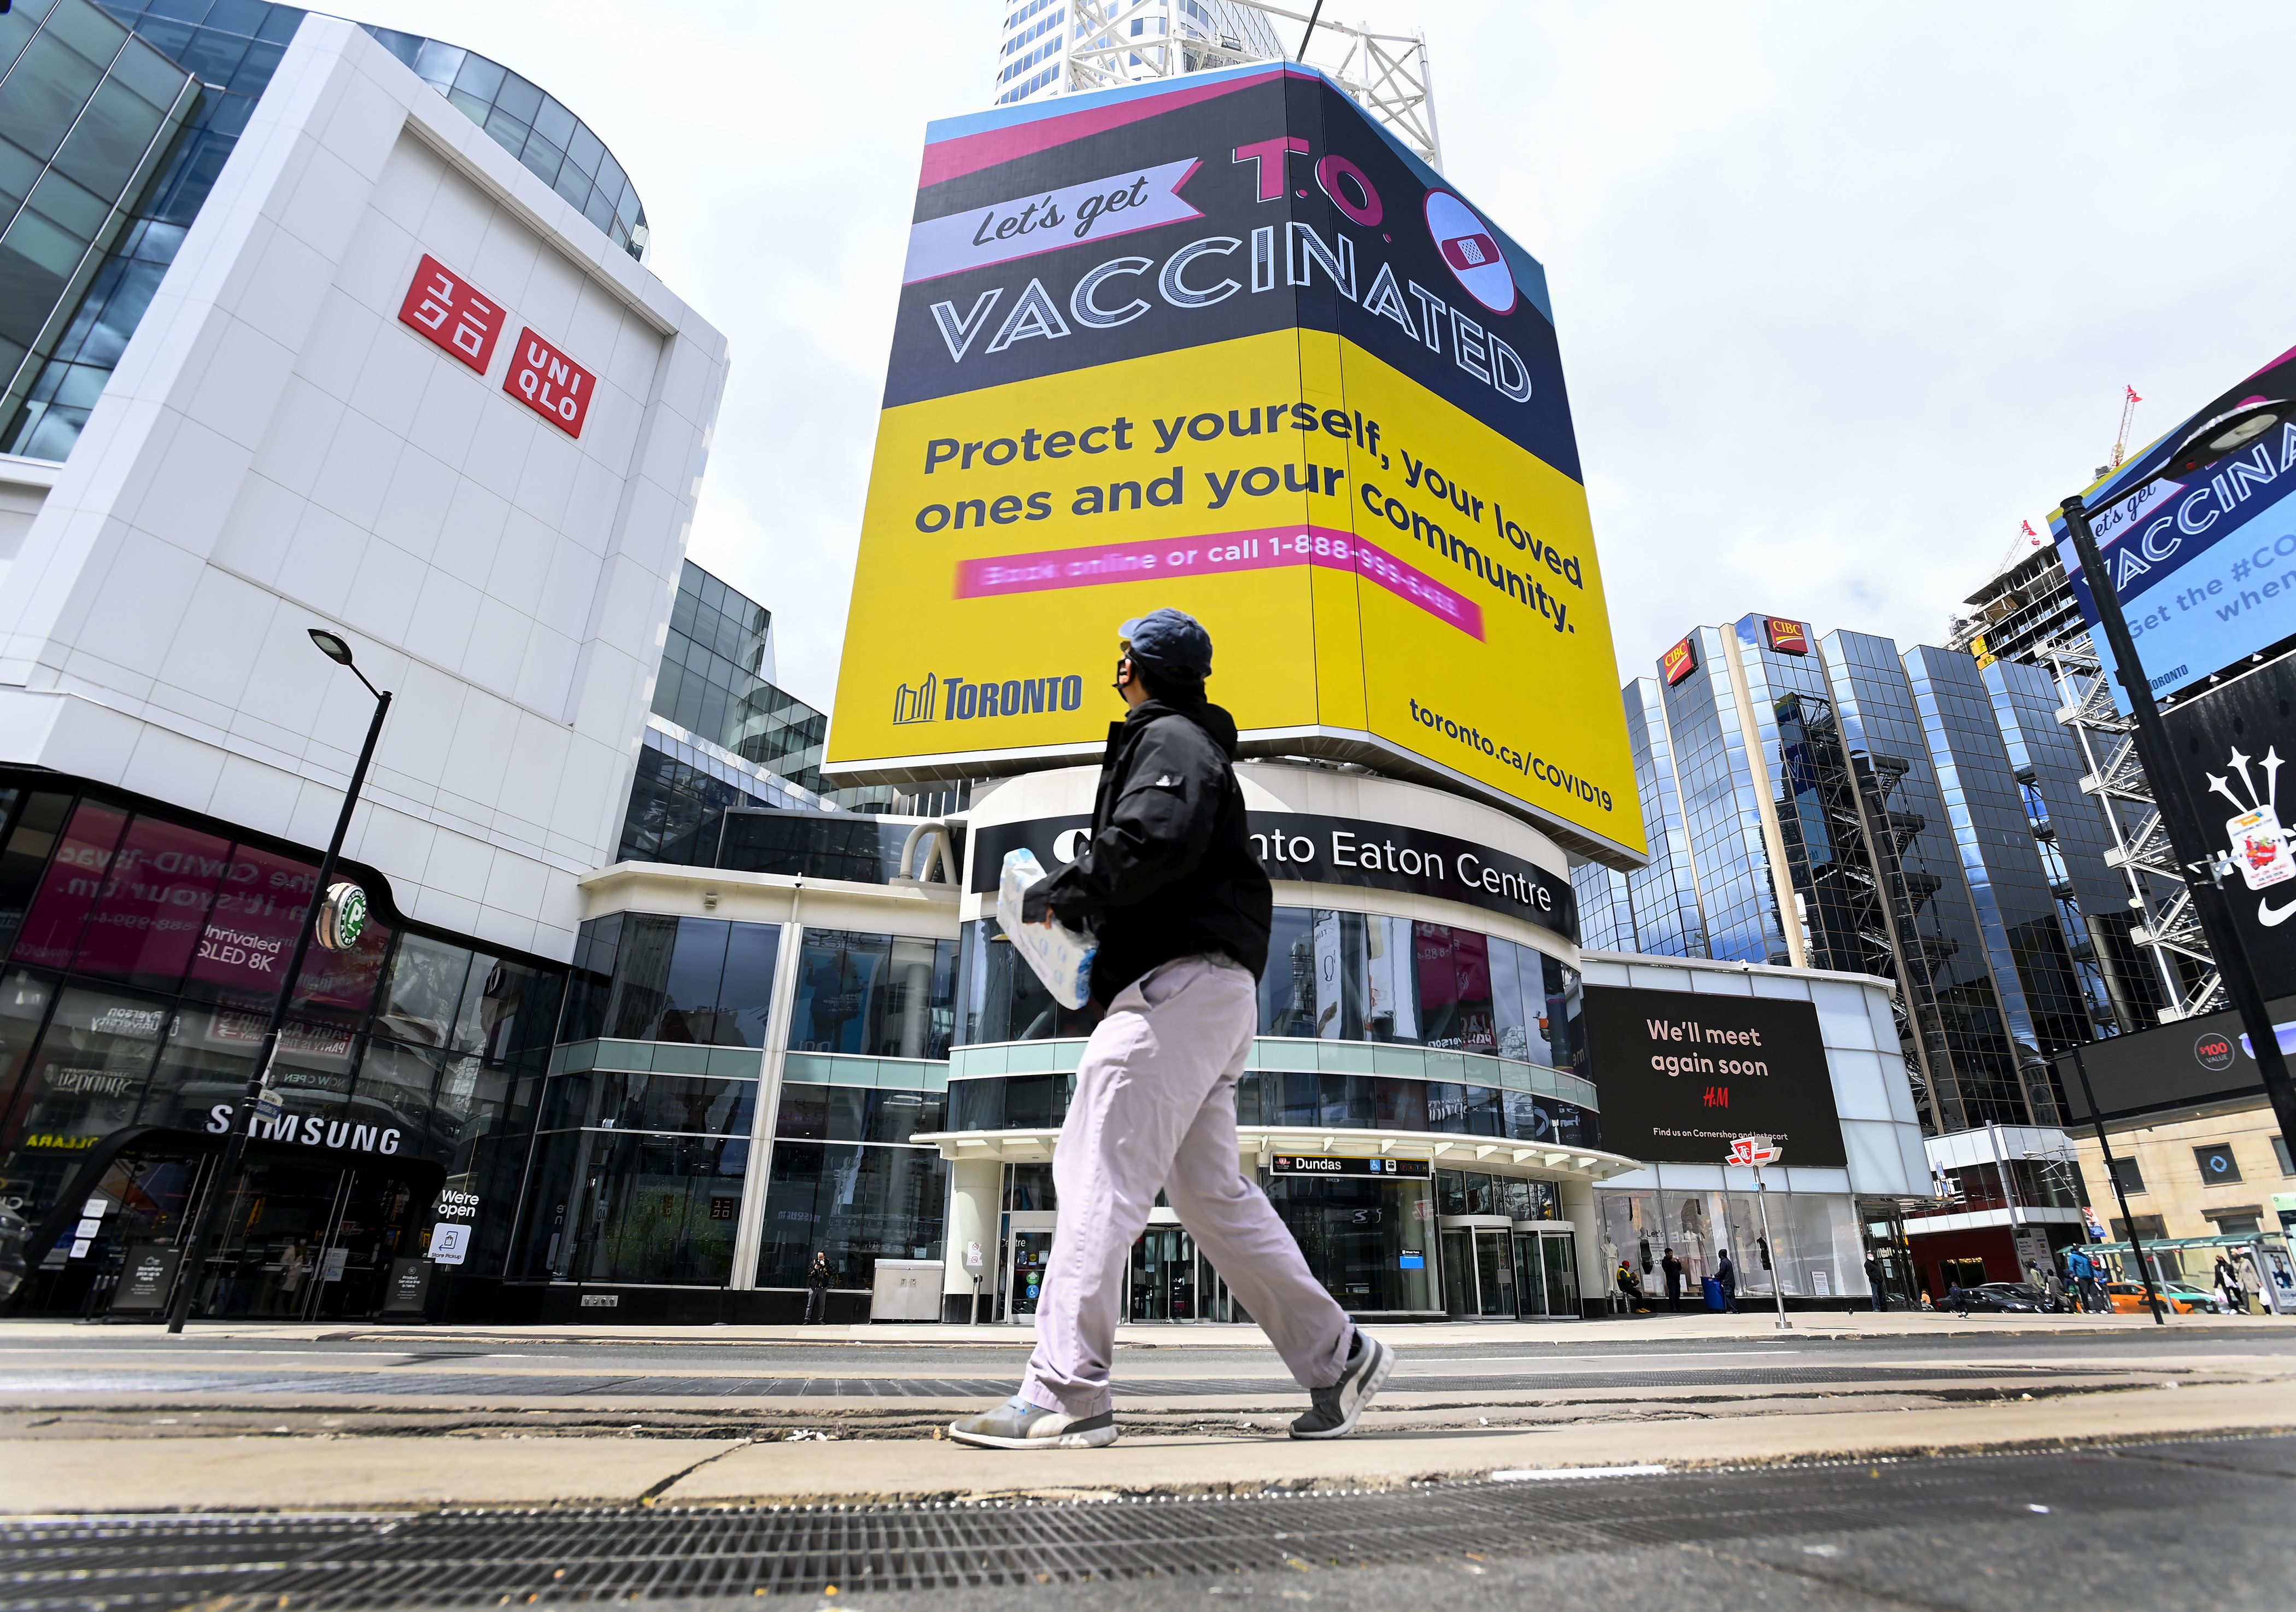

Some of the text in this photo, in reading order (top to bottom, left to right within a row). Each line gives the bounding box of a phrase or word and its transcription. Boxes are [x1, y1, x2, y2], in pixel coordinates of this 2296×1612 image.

[1233, 136, 1392, 243] T.O.
[972, 176, 1149, 247] Let's get
[930, 221, 1532, 403] VACCINATED
[924, 402, 1584, 590] Protect yourself, your loved
[2081, 422, 2296, 592] ACCINA
[2094, 484, 2156, 539] et's get
[915, 463, 1575, 634] ones and your community.
[1167, 548, 1198, 568] or
[1208, 539, 1258, 563] call
[2127, 605, 2171, 640] Get
[2176, 579, 2223, 611] the
[1772, 621, 1802, 636] CIBC
[1665, 642, 1687, 667] CIBC
[943, 674, 1082, 721] TORONTO
[1410, 698, 1613, 812] toronto.ca/COVID19
[1331, 831, 1444, 880] Eaton
[1456, 853, 1552, 912] Centre
[248, 953, 276, 972] 8K
[1647, 1019, 1762, 1047] We'll meet
[2199, 1042, 2228, 1056] $100
[2205, 1053, 2229, 1064] VALUE
[1651, 1052, 1769, 1077] again soon
[1703, 1087, 1729, 1109] H&M
[1653, 1128, 1671, 1136] Find
[1693, 1129, 1737, 1140] Cornershop
[1296, 1157, 1342, 1170] Dundas
[442, 1189, 479, 1205] We're
[438, 1204, 476, 1219] open
[1001, 1239, 1026, 1247] Cetre
